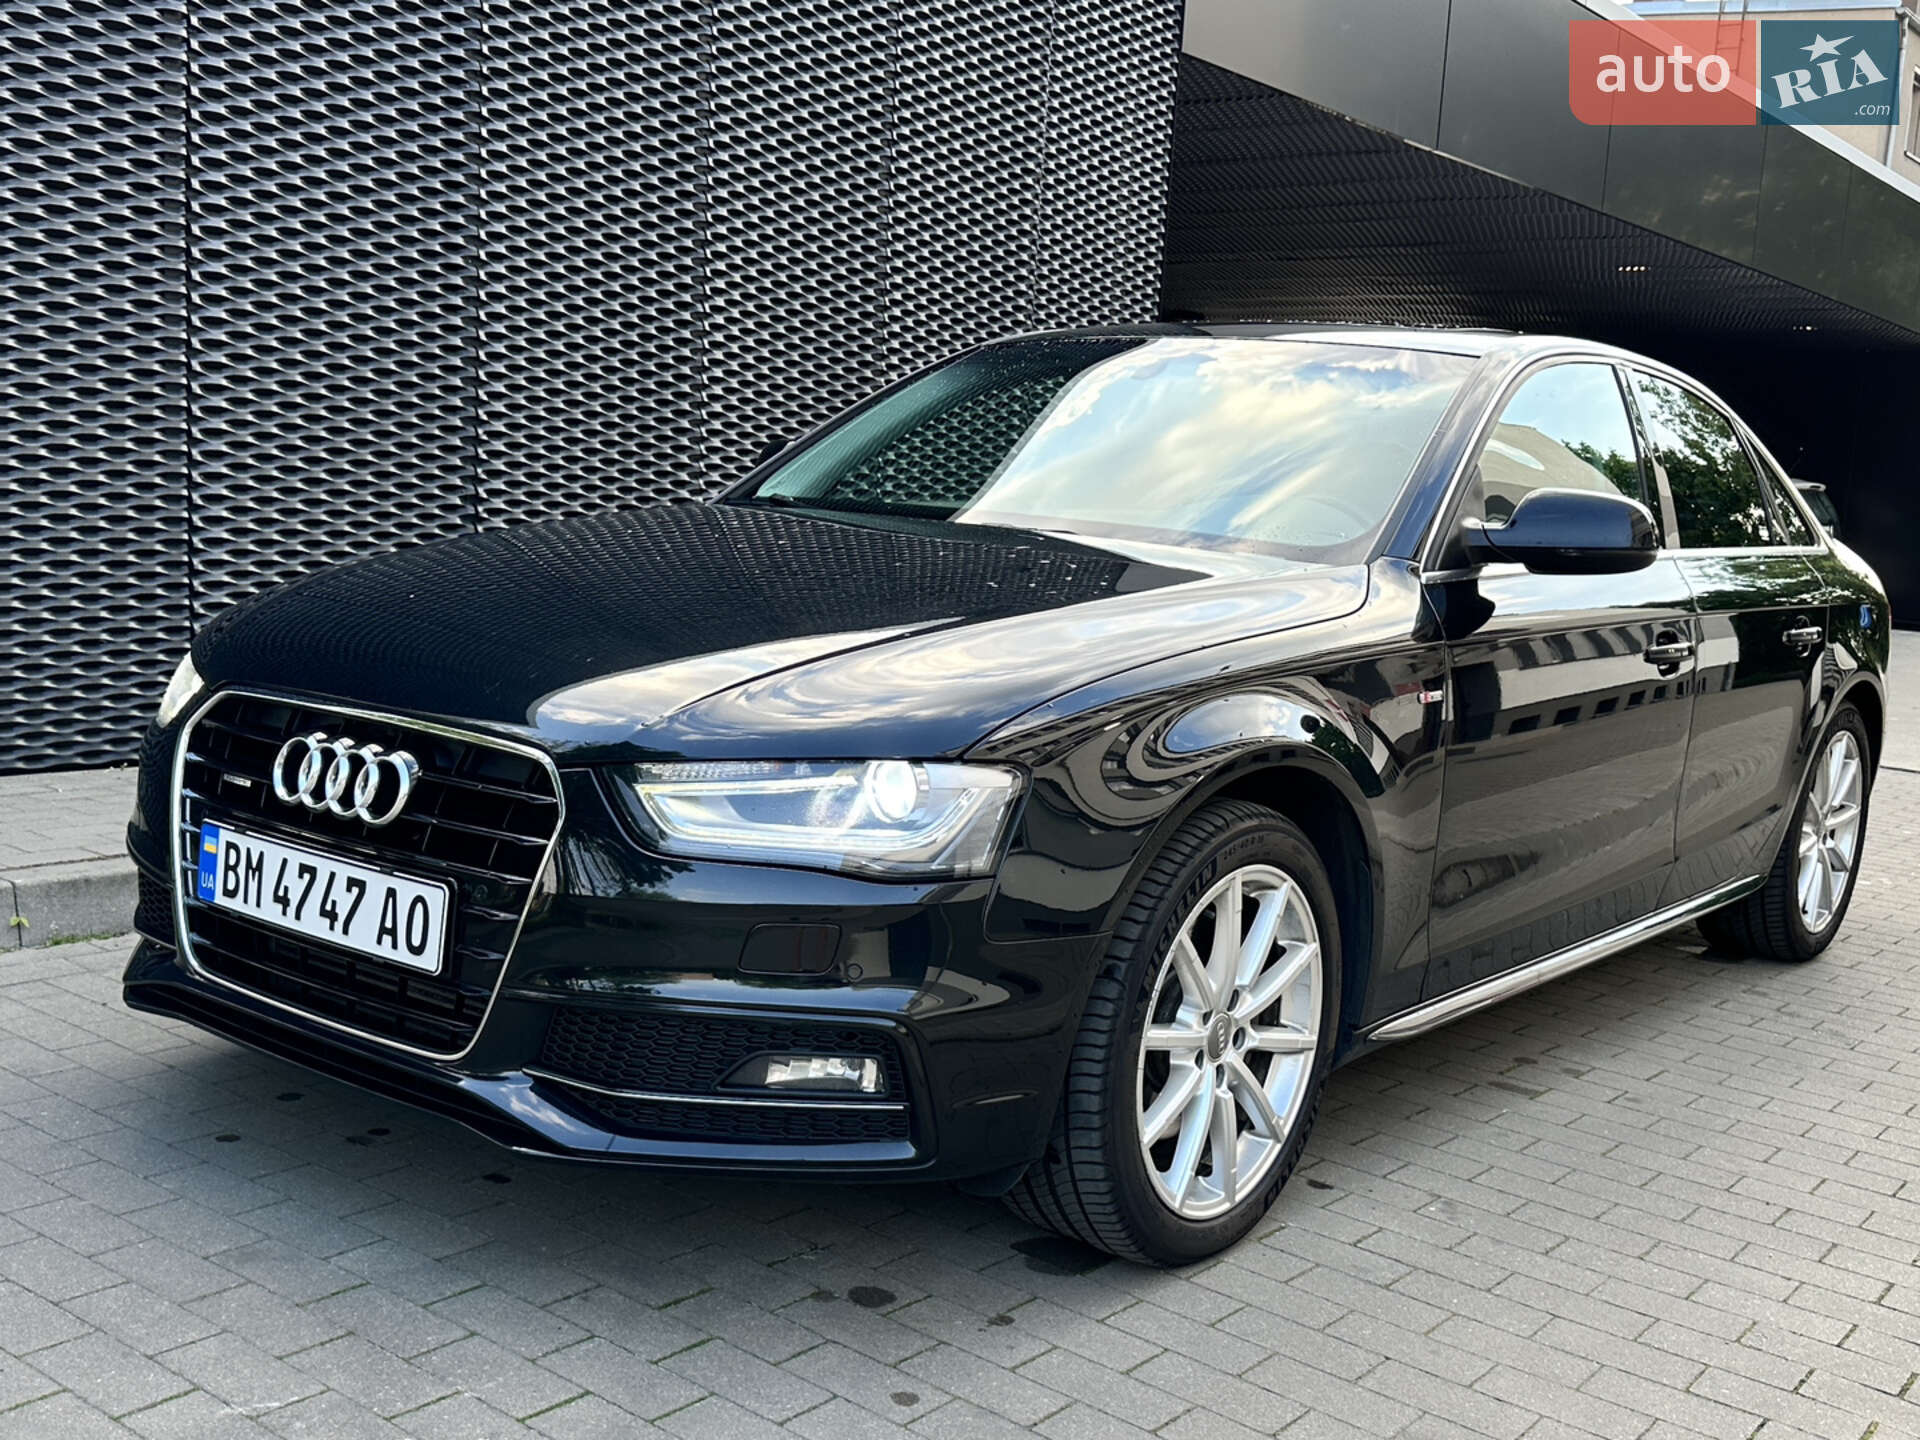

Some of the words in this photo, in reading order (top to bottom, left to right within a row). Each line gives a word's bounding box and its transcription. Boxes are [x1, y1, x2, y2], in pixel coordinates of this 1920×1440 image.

[201, 872, 214, 890] UA
[223, 840, 264, 908] BM
[273, 857, 367, 936] 4747
[376, 887, 430, 956] AO
